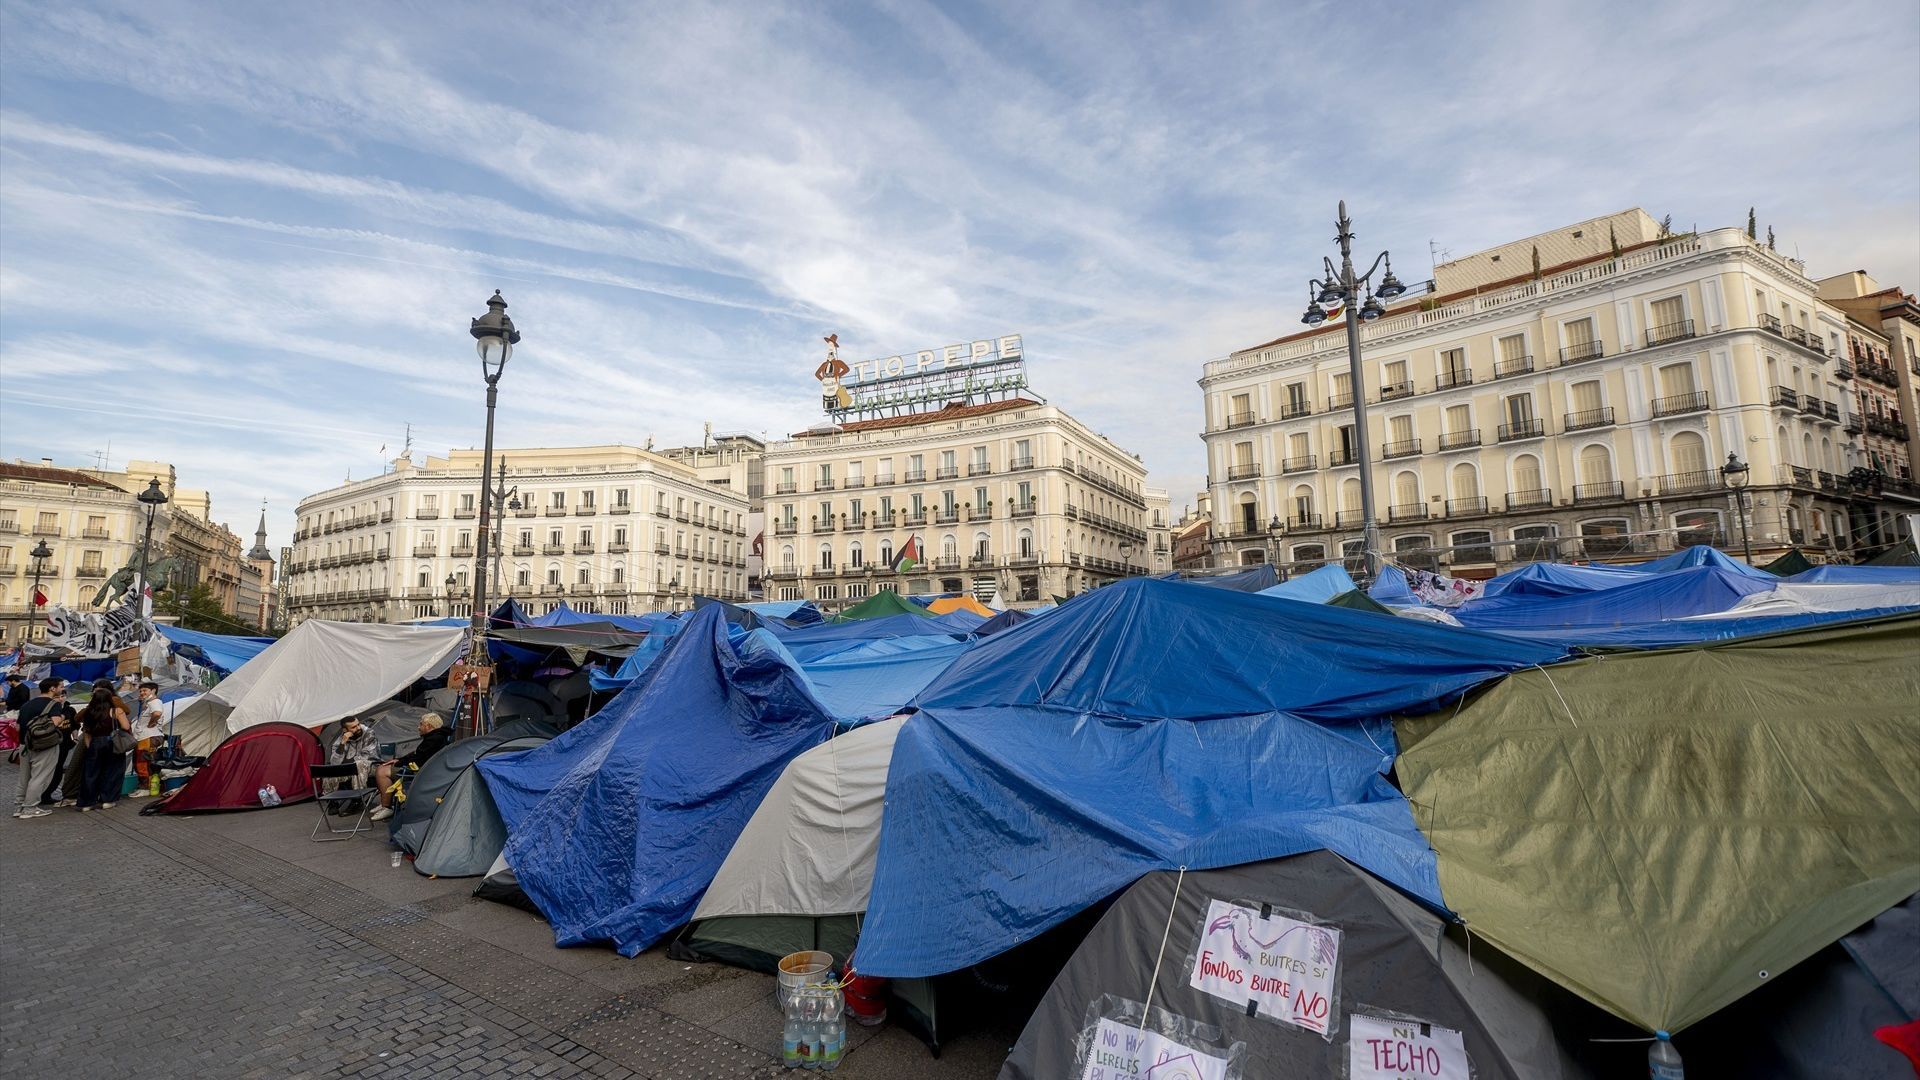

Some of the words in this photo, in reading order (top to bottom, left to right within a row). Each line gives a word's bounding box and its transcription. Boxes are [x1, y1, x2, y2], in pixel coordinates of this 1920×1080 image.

[853, 355, 904, 382] TIO
[917, 334, 1021, 373] PEPE
[281, 547, 290, 577] HOTEL
[276, 580, 288, 622] MODERNO
[1260, 951, 1308, 976] BUITRES
[1250, 974, 1291, 999] BUITRE
[1293, 988, 1329, 1019] NO
[1102, 1028, 1118, 1048] NO
[1096, 1049, 1140, 1075] LERELES
[1366, 1039, 1441, 1076] TECHO
